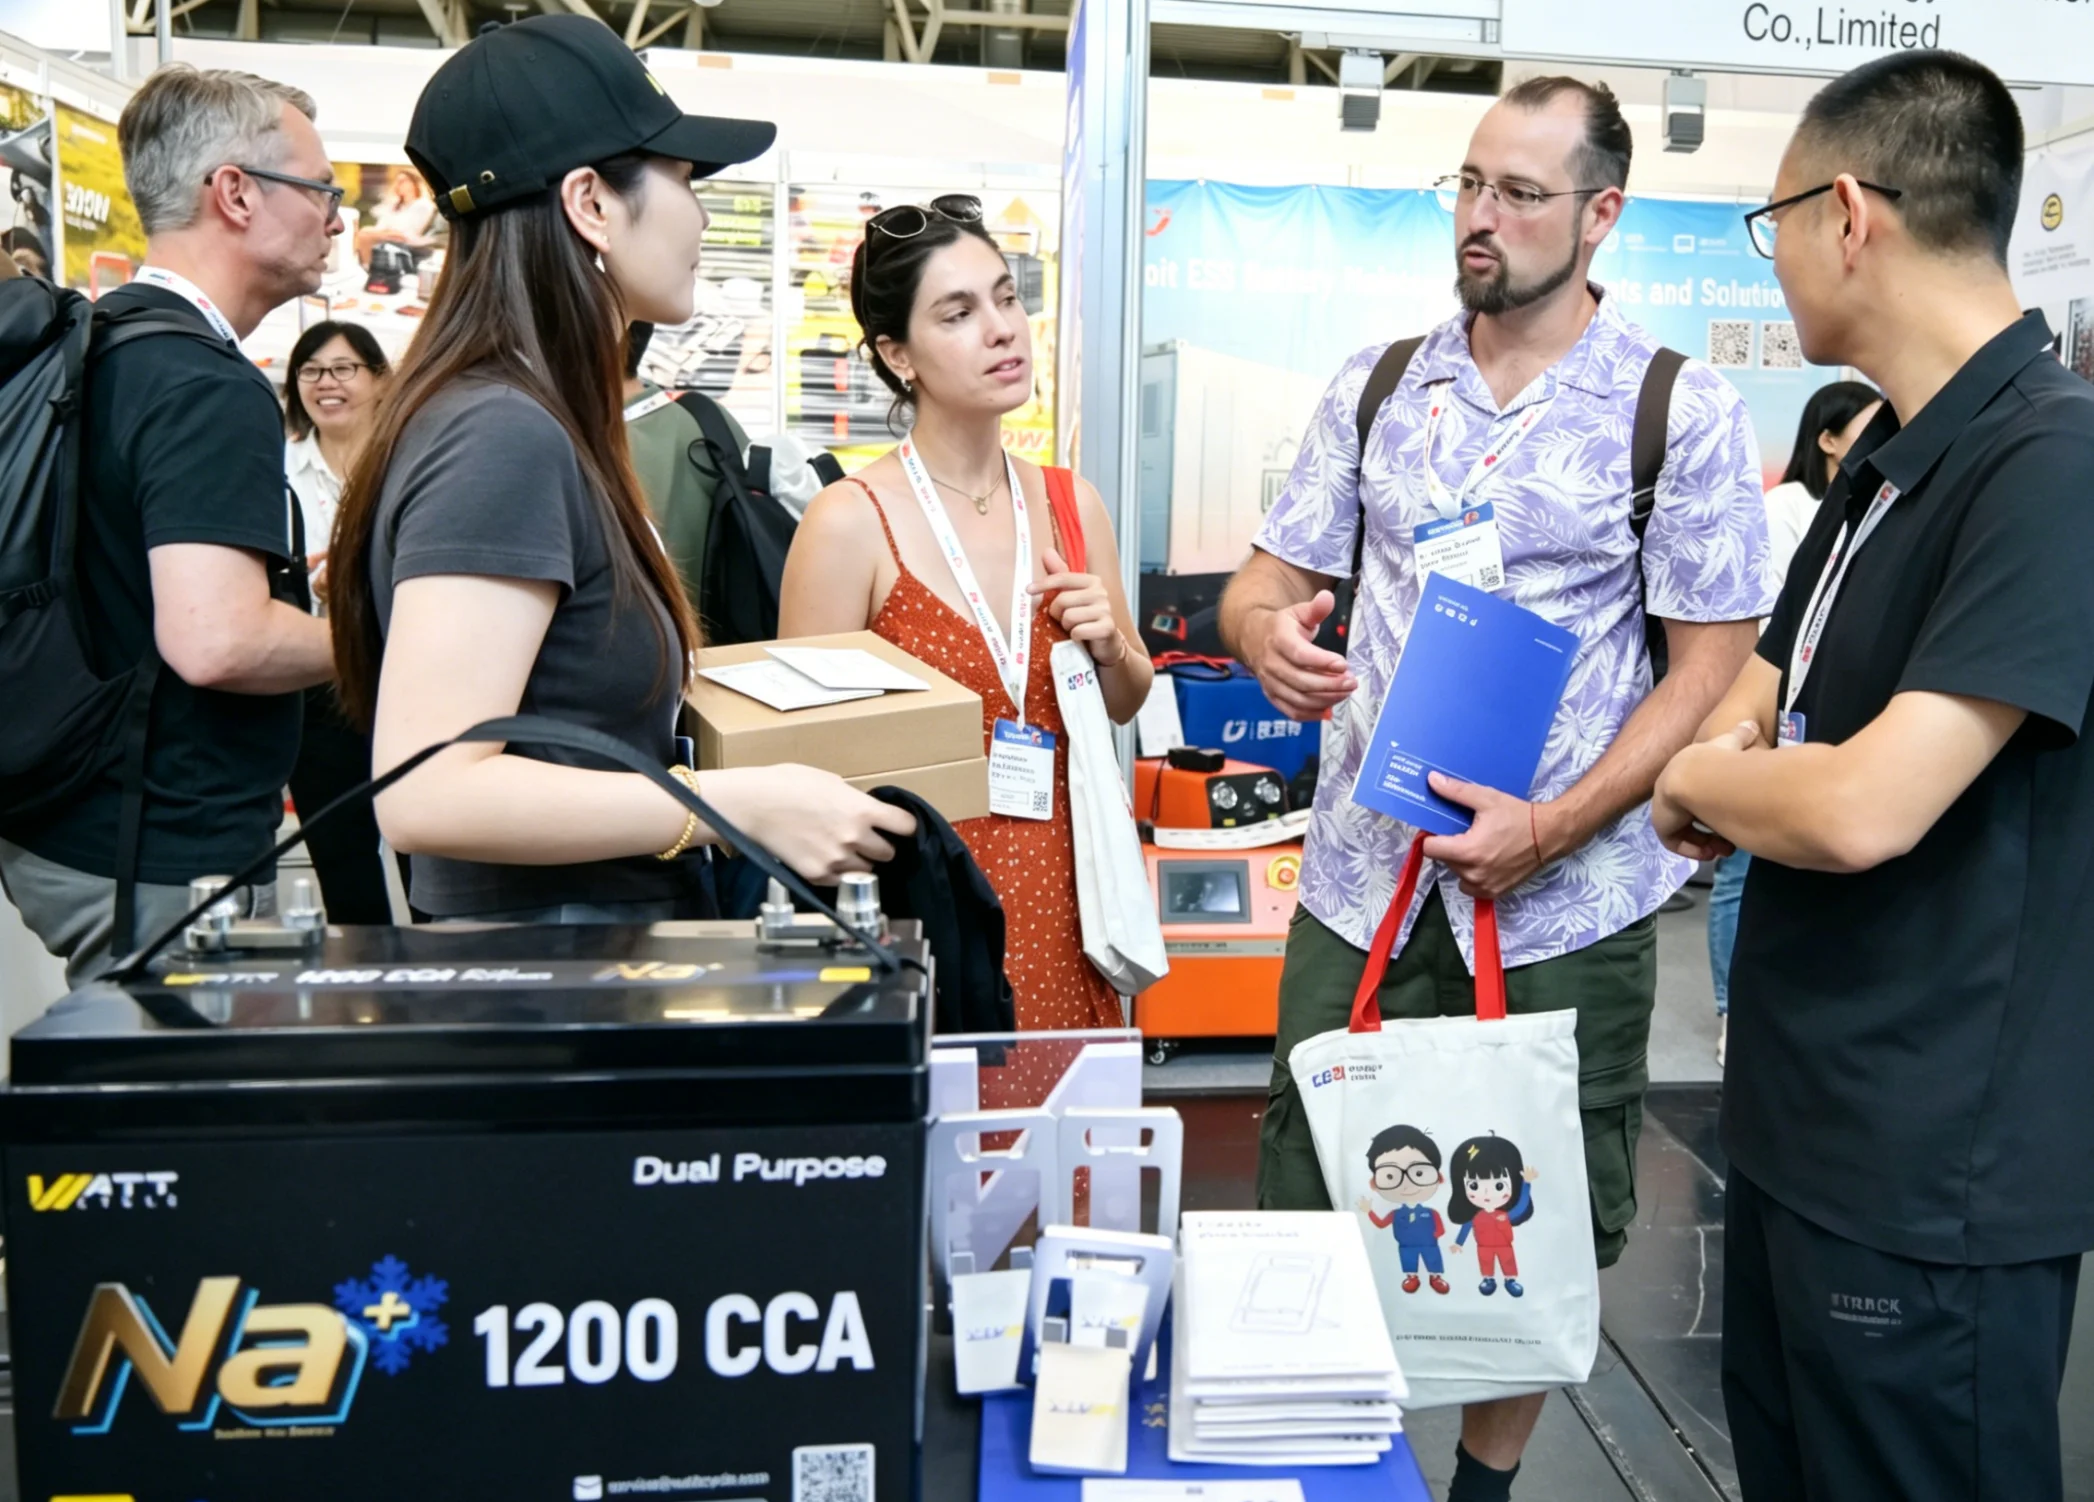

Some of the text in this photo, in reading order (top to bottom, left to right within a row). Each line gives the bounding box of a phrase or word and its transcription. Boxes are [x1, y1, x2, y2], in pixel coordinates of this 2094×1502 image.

[1743, 2, 1940, 51] Co.,Limited
[1650, 276, 1693, 306] and
[633, 1152, 888, 1187] Dual Purpose
[27, 1170, 179, 1211] WATT
[474, 1290, 876, 1388] 1200 CCA
